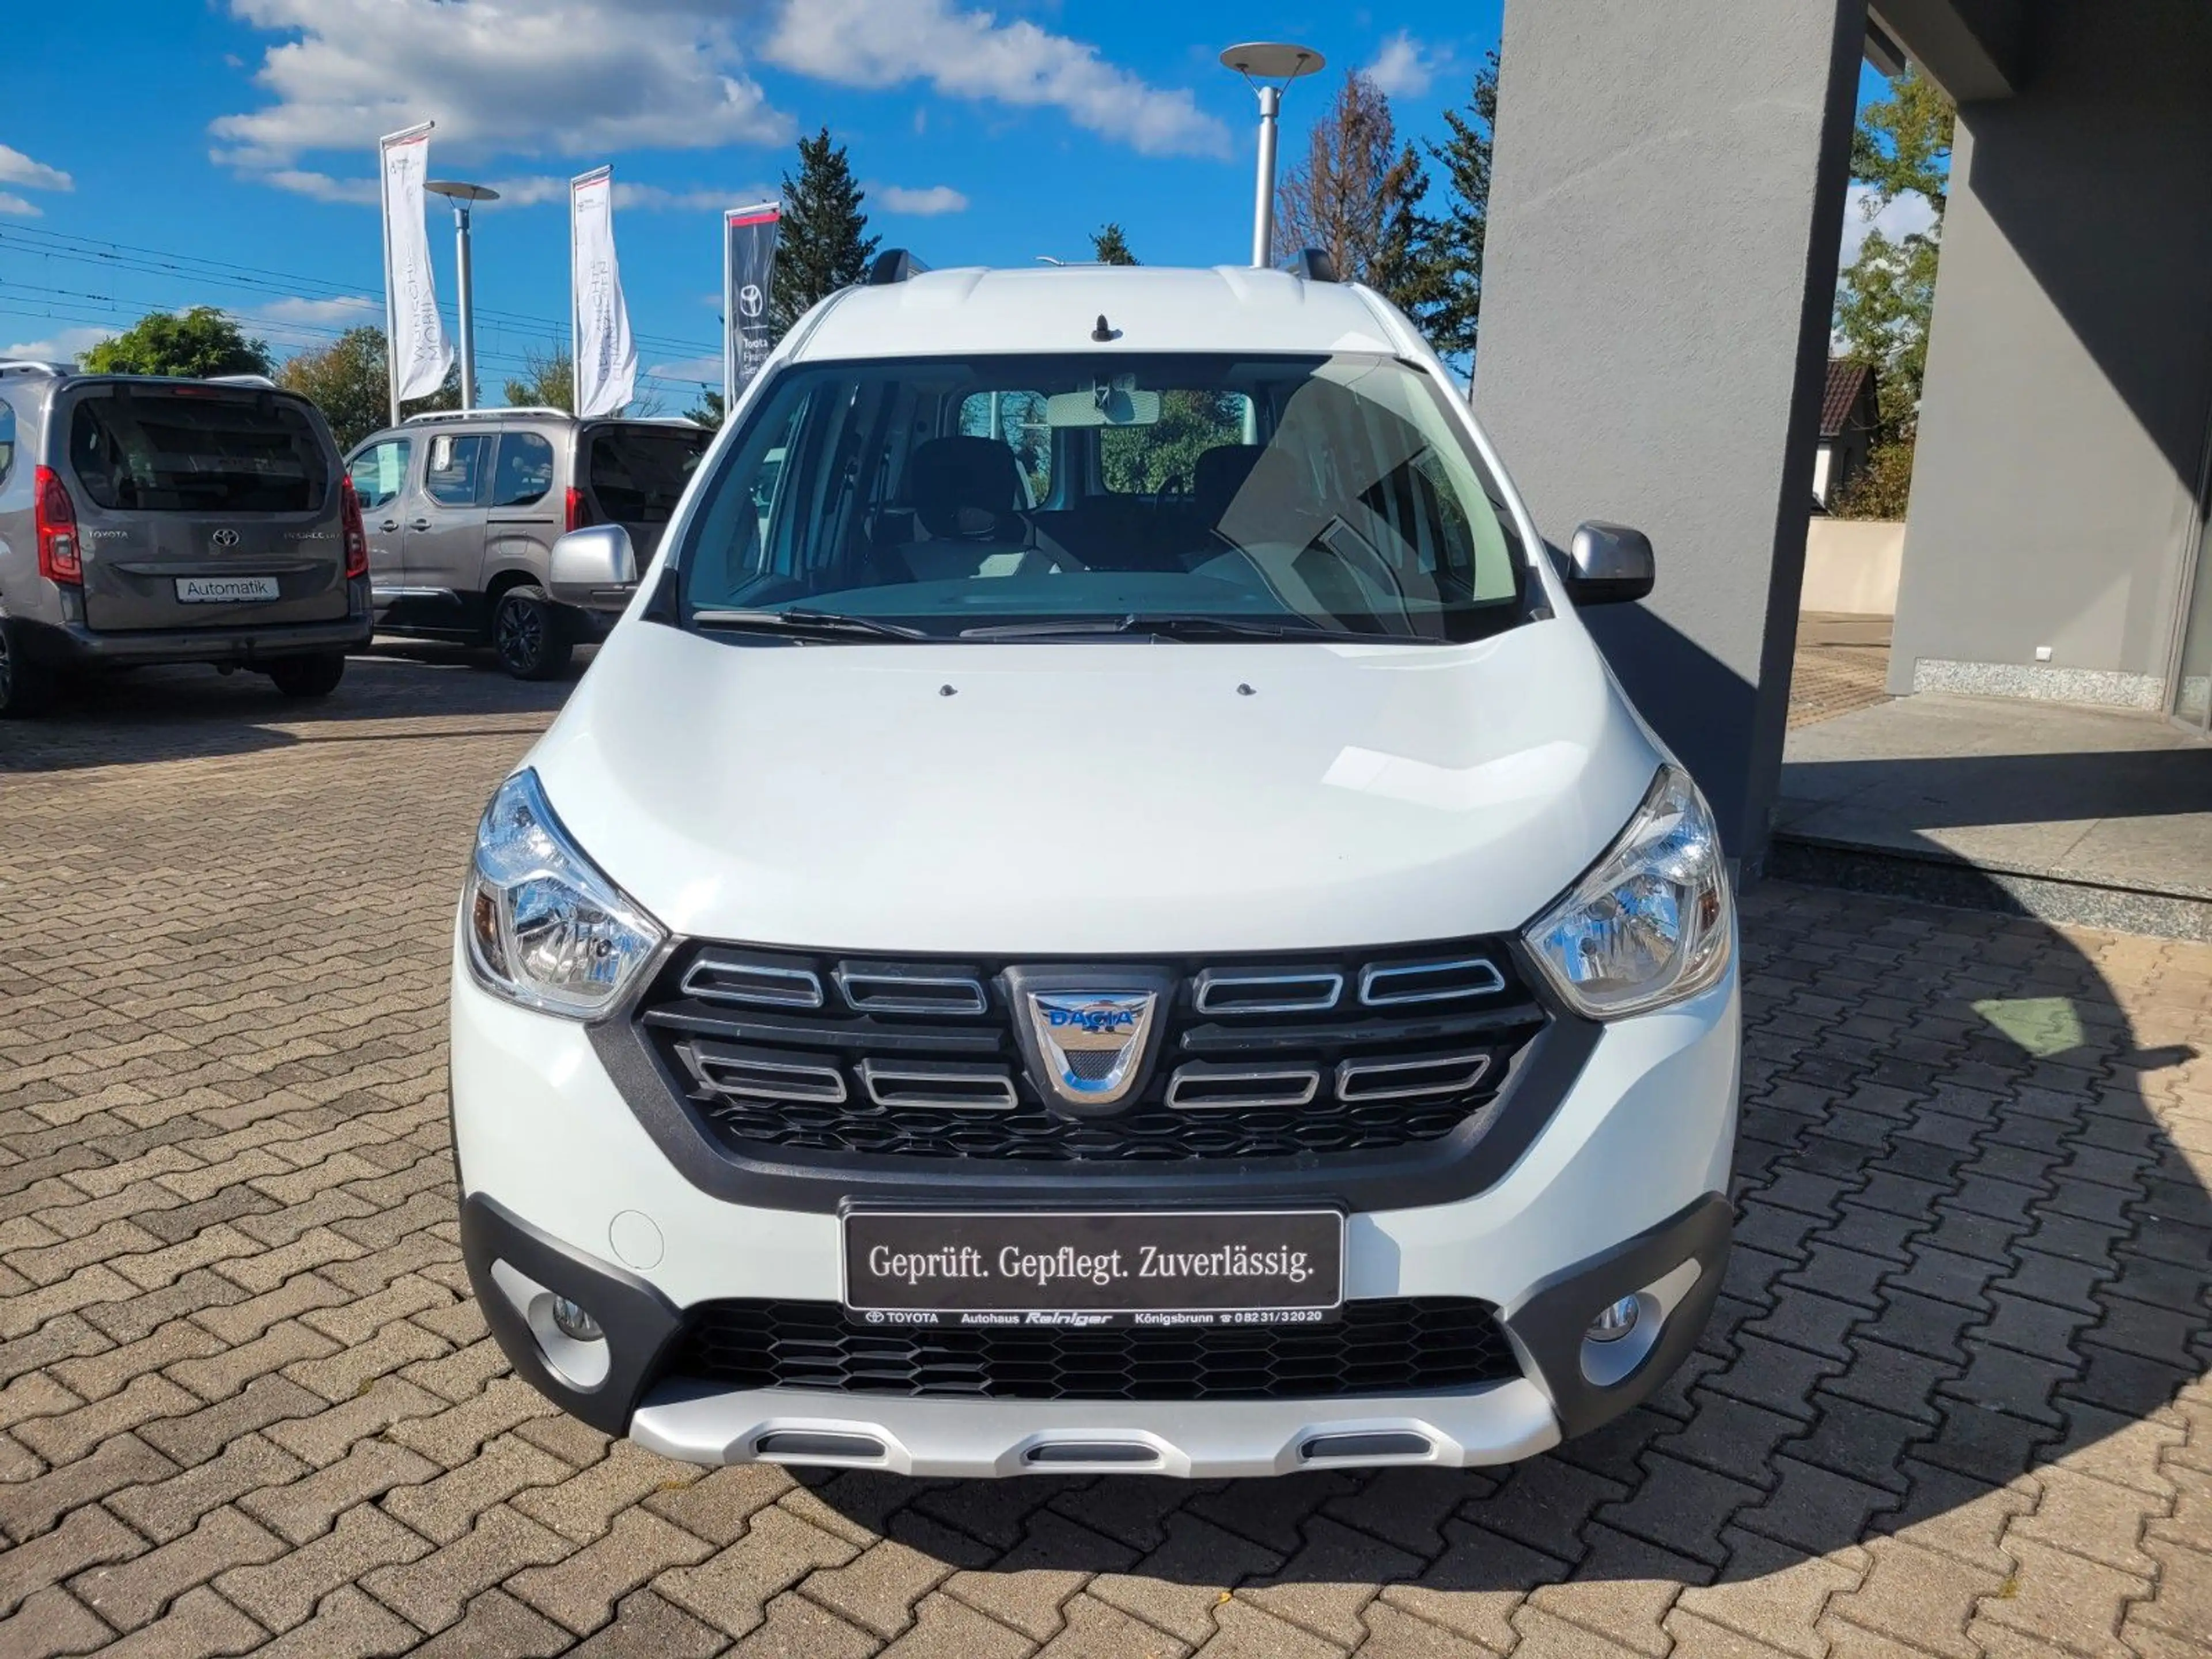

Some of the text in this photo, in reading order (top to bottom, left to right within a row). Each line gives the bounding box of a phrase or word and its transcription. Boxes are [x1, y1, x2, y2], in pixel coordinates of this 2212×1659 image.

[88, 531, 128, 539] TOYOTA
[187, 582, 268, 596] Automatik
[1050, 1010, 1134, 1025] DACIA
[869, 1245, 1314, 1286] Geprüft. Gepflegt. Zuverlässig.
[887, 1313, 939, 1323] TOYOTA
[961, 1313, 1020, 1324] Autohaus
[1025, 1312, 1113, 1327] Reiniger
[1135, 1313, 1214, 1325] Königsbrunn
